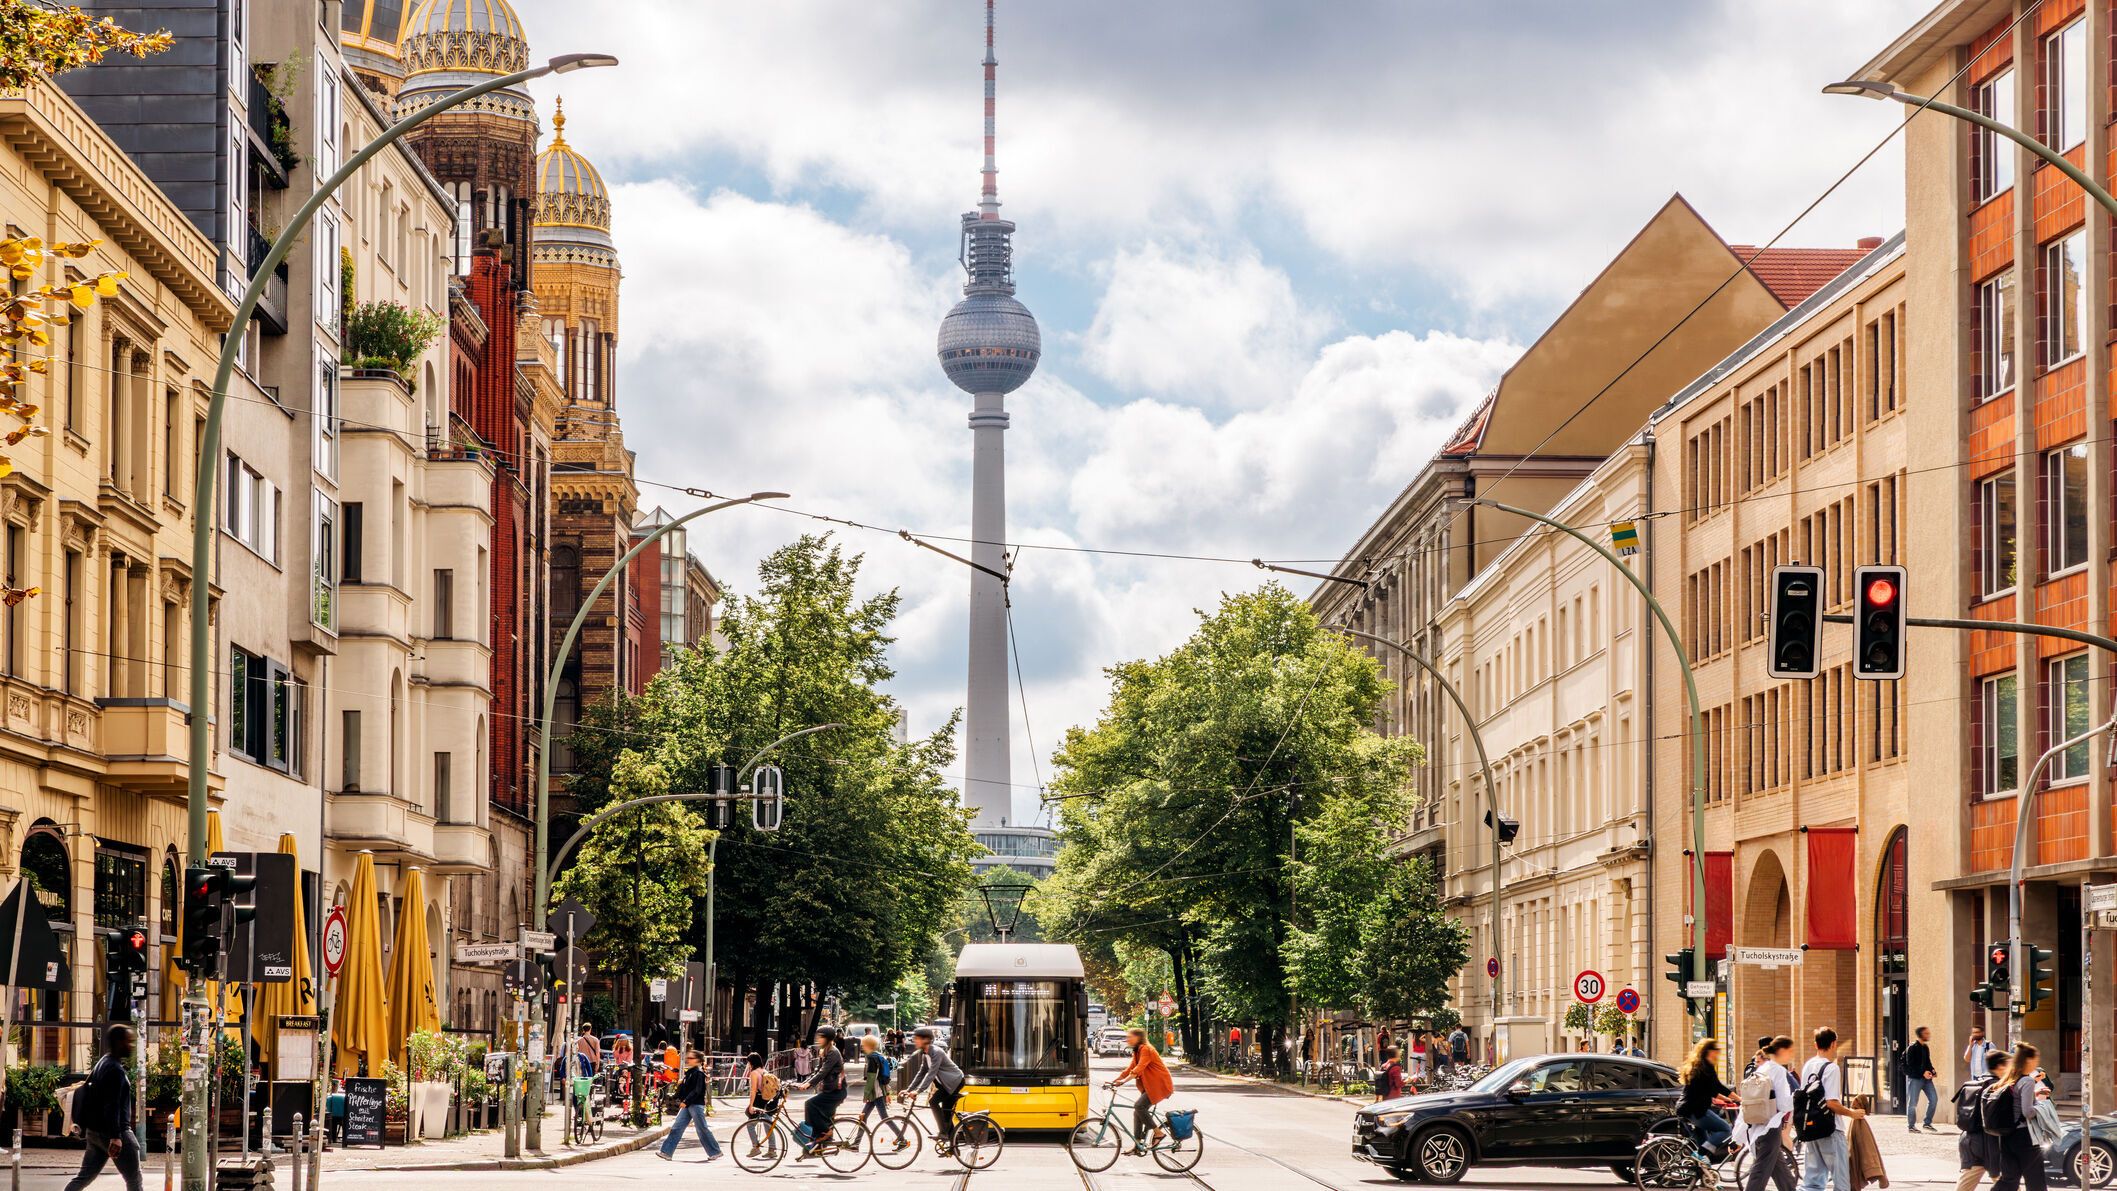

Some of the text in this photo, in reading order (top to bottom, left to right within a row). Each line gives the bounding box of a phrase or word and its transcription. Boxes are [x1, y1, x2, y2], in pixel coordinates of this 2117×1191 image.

[1622, 546, 1637, 556] LZA
[464, 947, 509, 957] Tucholskystraße
[1740, 951, 1799, 962] Tucholskystraße
[1580, 979, 1599, 995] 30
[348, 1120, 367, 1130] Steak
